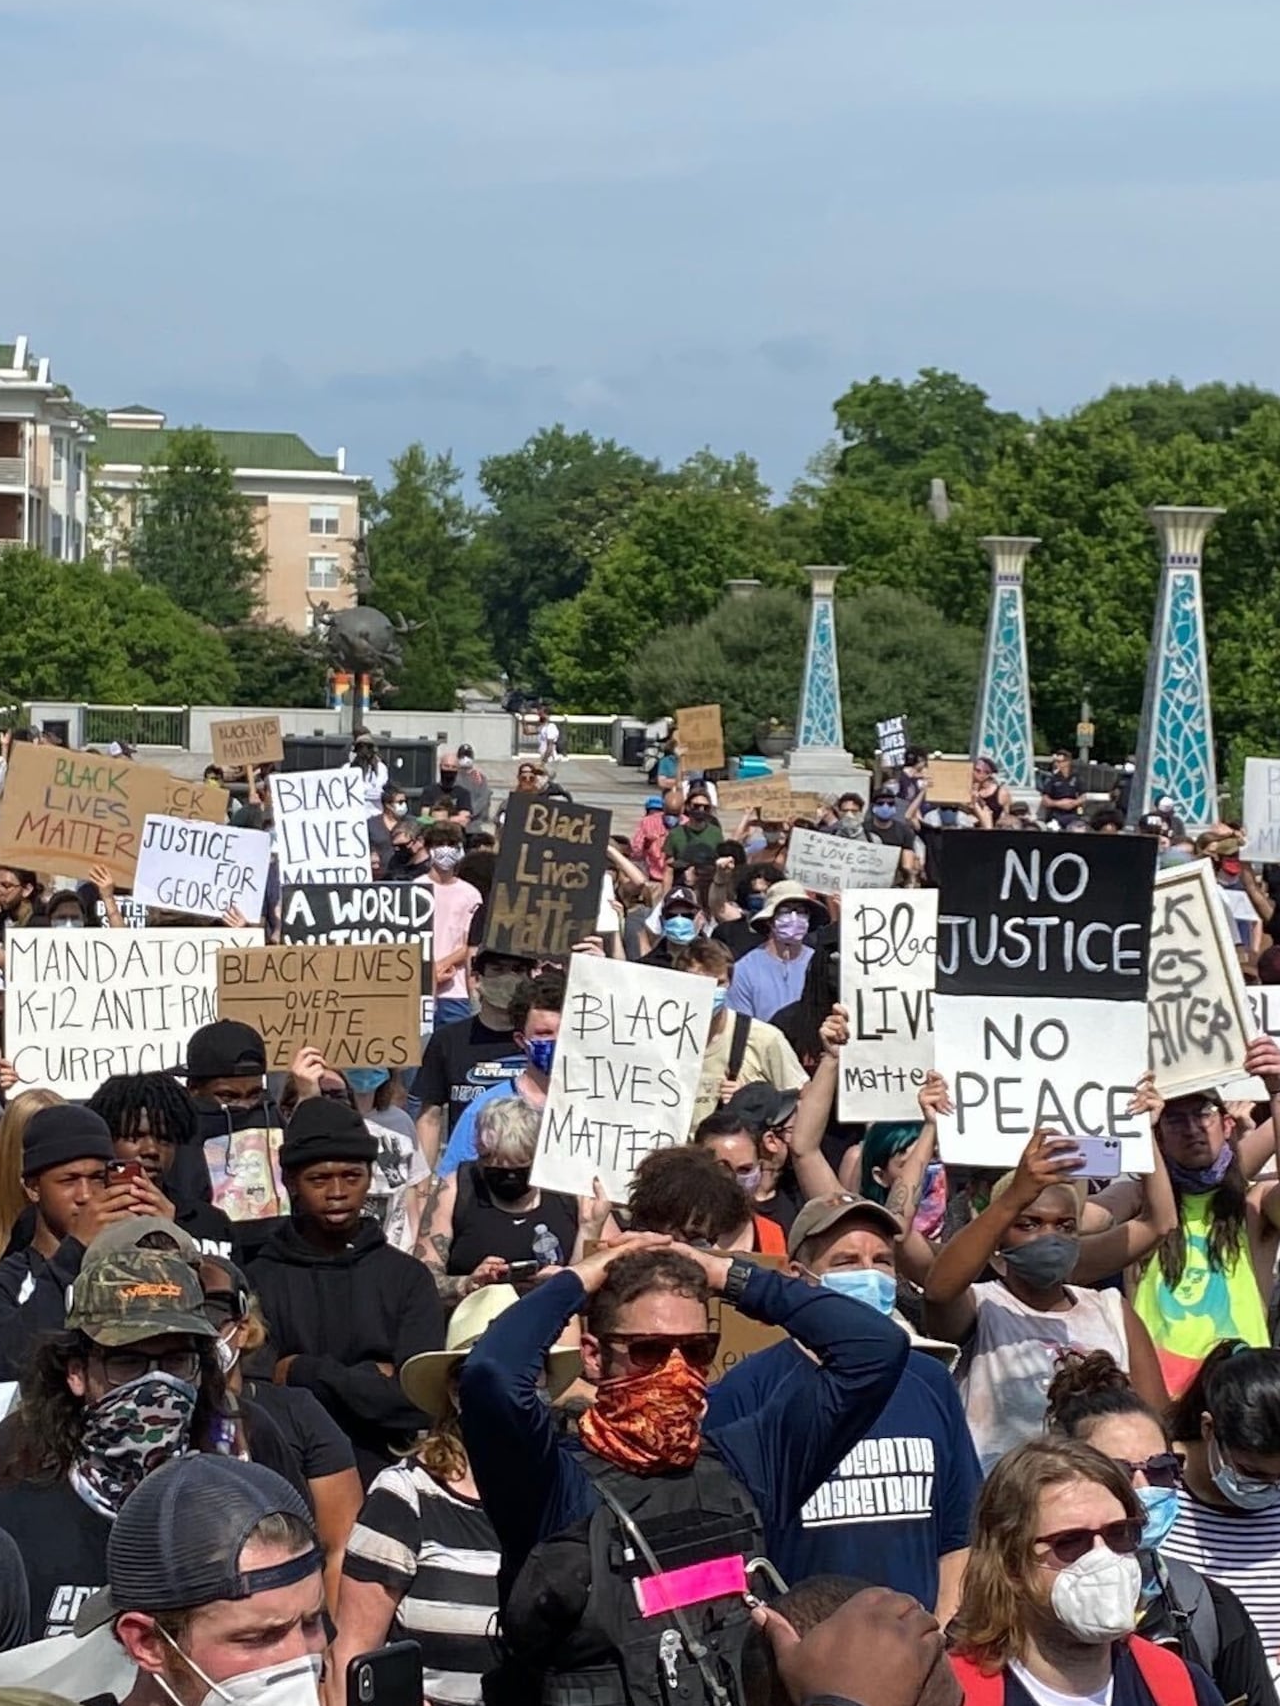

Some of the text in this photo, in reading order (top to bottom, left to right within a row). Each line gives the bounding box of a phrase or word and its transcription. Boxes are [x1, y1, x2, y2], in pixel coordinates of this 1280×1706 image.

[54, 757, 129, 800] BLACK
[277, 777, 363, 813] BLACK
[44, 793, 130, 827] LIVES
[524, 804, 596, 844] Black
[15, 811, 137, 860] MATTER
[144, 822, 239, 863] JUSTICE
[280, 820, 367, 865] LIVES
[819, 845, 854, 866] LOVE
[214, 863, 257, 892] FOR
[516, 845, 590, 890] Lives
[1000, 848, 1089, 902] NO
[158, 877, 242, 911] GEORGE
[285, 885, 435, 927] A WORLD
[10, 936, 253, 983] MANDATOR
[855, 903, 938, 975] Blac
[936, 915, 1142, 975] JUSTICE
[224, 948, 415, 985] BLACK LIVES
[17, 990, 80, 1031] K-12
[285, 990, 340, 1010] OVER
[259, 1008, 365, 1036] WHITE
[572, 994, 699, 1058] BLACK
[984, 1014, 1069, 1061] NO
[562, 1056, 681, 1107] LIVES
[956, 1069, 1142, 1138] PEACE
[801, 1475, 934, 1521] BASKETBALL
